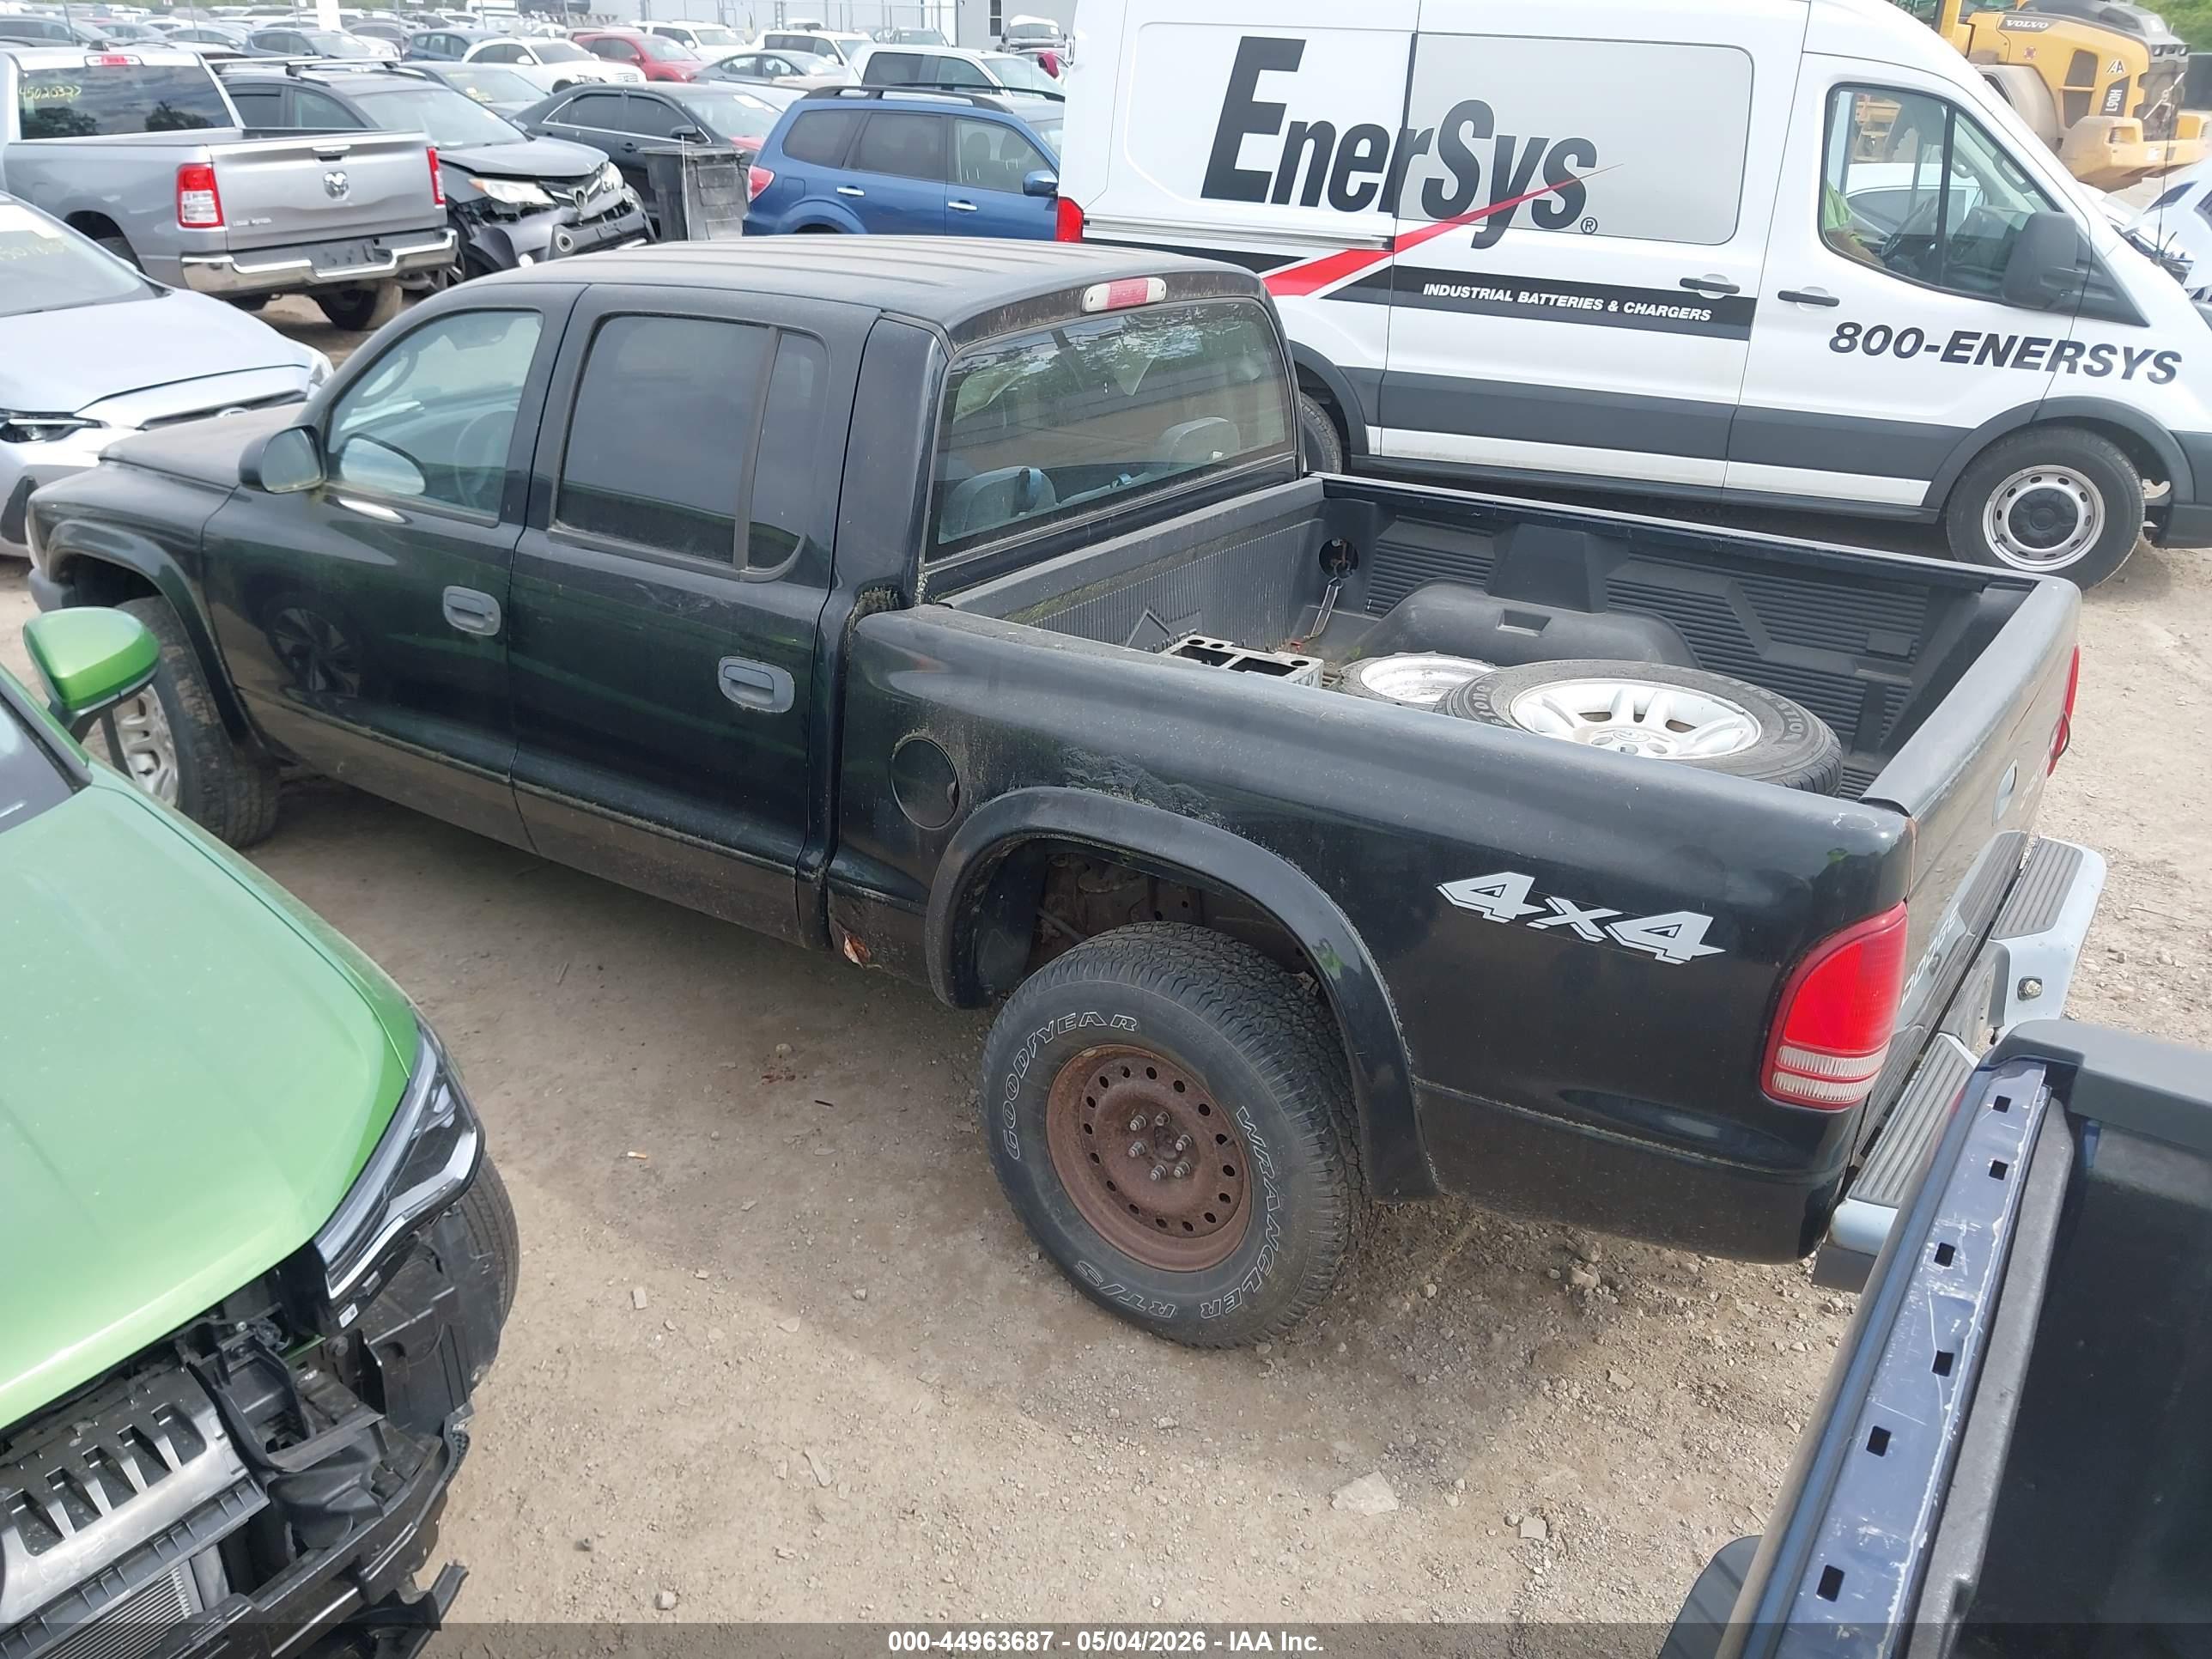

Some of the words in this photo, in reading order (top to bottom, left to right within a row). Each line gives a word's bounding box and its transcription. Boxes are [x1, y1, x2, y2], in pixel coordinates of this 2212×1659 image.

[2005, 19, 2049, 29] VOLVO
[2105, 88, 2124, 112] L90H
[1200, 35, 1598, 249] EnerSys
[1423, 283, 1513, 302] INDUSTRIAL
[1517, 291, 1603, 312] BATTERIES
[1607, 301, 1620, 313] &
[1623, 301, 1712, 321] CHARGERS
[1829, 321, 2183, 386] 800-ENERSYS
[1900, 902, 1960, 1009] DODGE
[1002, 1011, 1138, 1161] GOODYEAR
[1200, 1104, 1281, 1320] WRANGLER
[1075, 1260, 1176, 1319] RT/S
